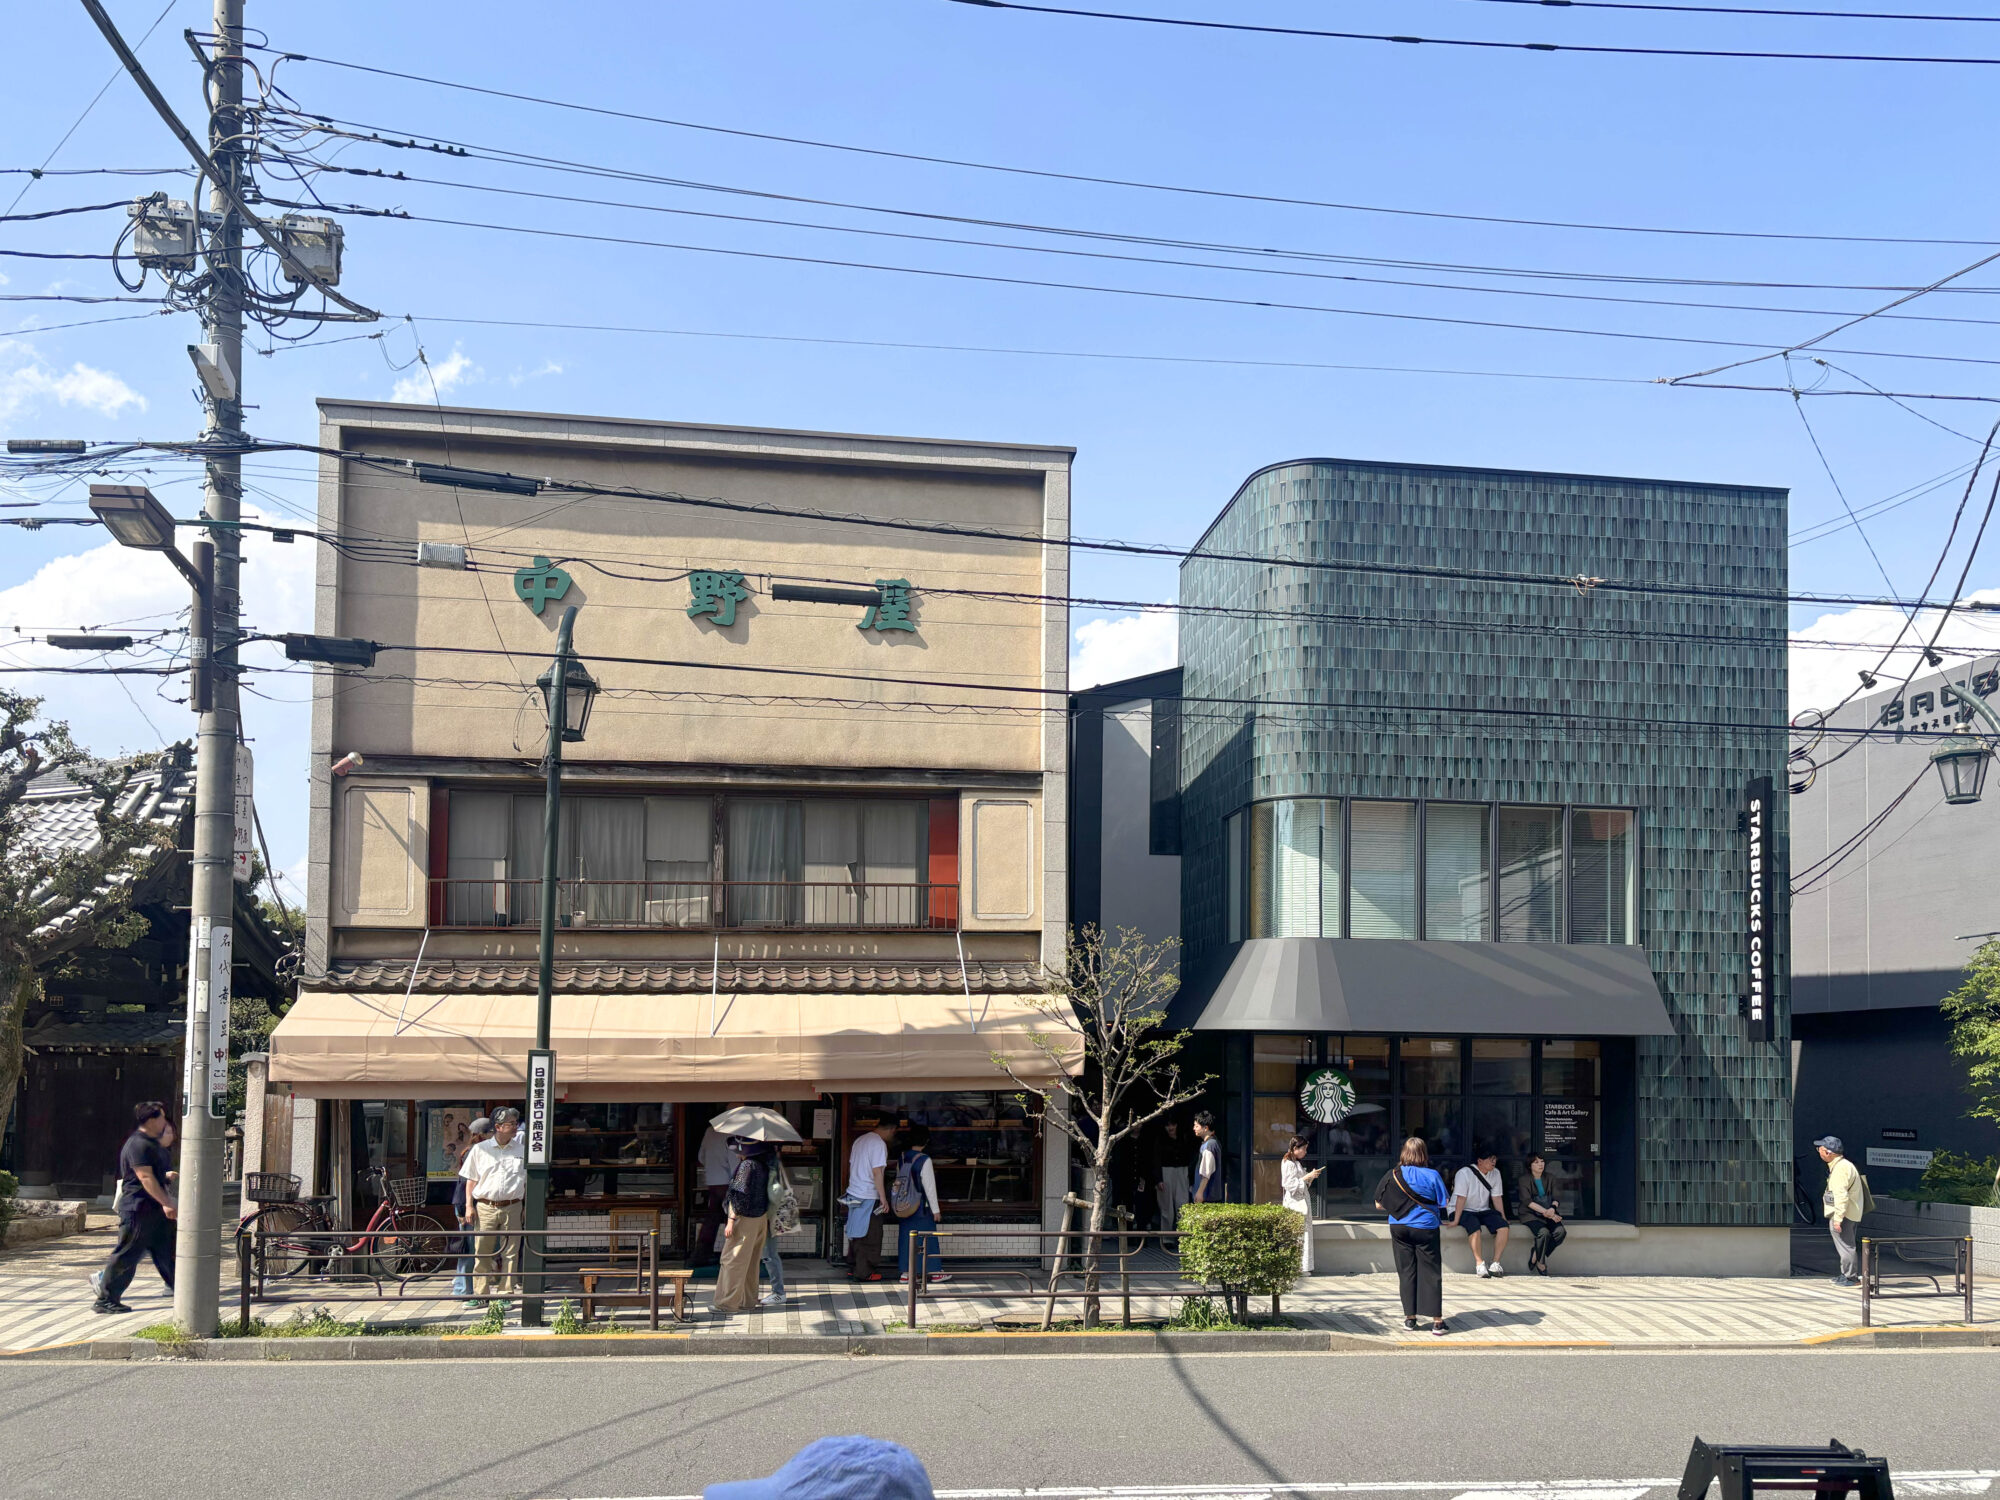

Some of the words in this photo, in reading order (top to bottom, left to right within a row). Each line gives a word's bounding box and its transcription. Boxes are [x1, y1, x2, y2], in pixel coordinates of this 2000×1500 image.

[514, 555, 918, 633] 中野屋
[1750, 799, 1761, 932] STARBUCKS
[1750, 936, 1762, 1021] COFFEE
[532, 1067, 545, 1152] 日暮里西口商店会
